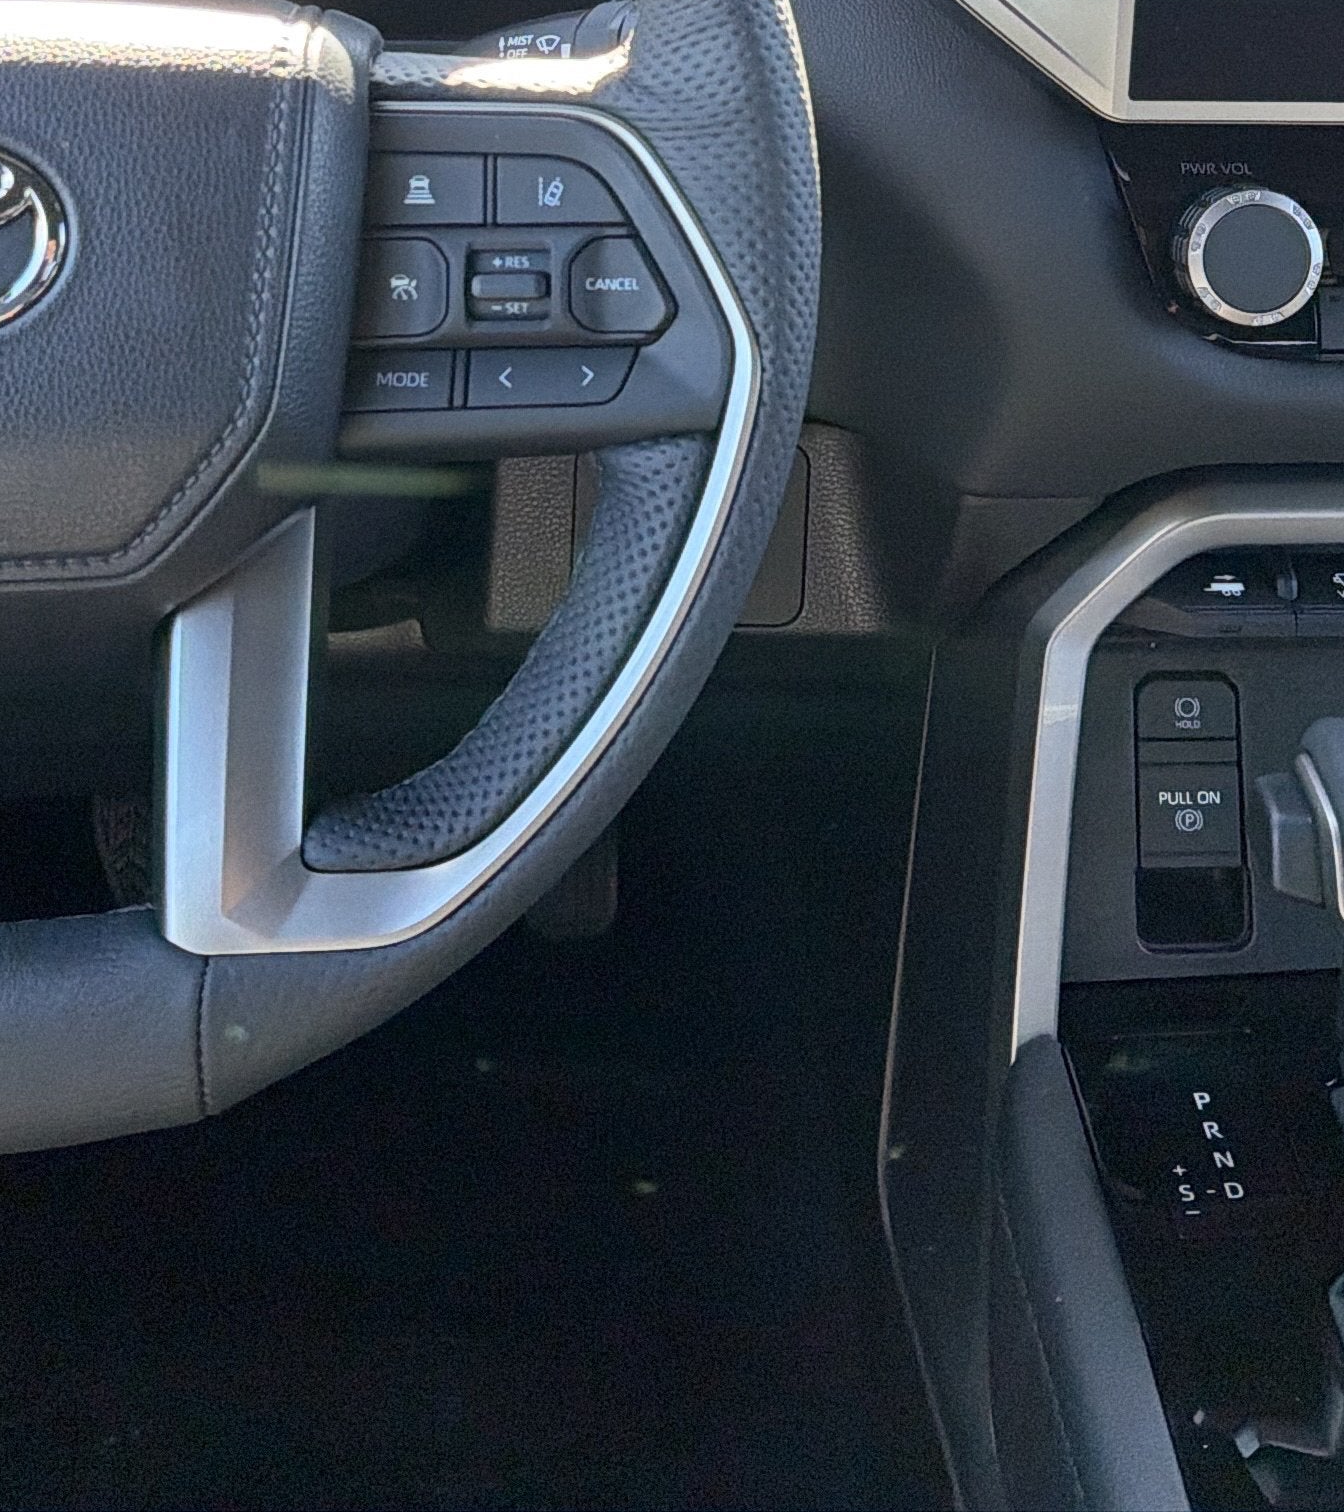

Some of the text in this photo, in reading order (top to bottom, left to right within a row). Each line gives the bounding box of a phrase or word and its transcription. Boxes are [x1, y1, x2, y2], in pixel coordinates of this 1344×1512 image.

[507, 34, 534, 47] MIST
[506, 48, 528, 59] OFF
[1180, 161, 1253, 175] PWR VOL
[584, 277, 640, 291] CANCEL
[376, 371, 430, 388] MODE
[1175, 719, 1201, 729] HOLD
[1158, 790, 1221, 805] PULL ON
[1193, 1092, 1211, 1110] P
[1202, 1121, 1225, 1140] R
[1212, 1150, 1235, 1169] N
[1178, 1182, 1244, 1202] S D
